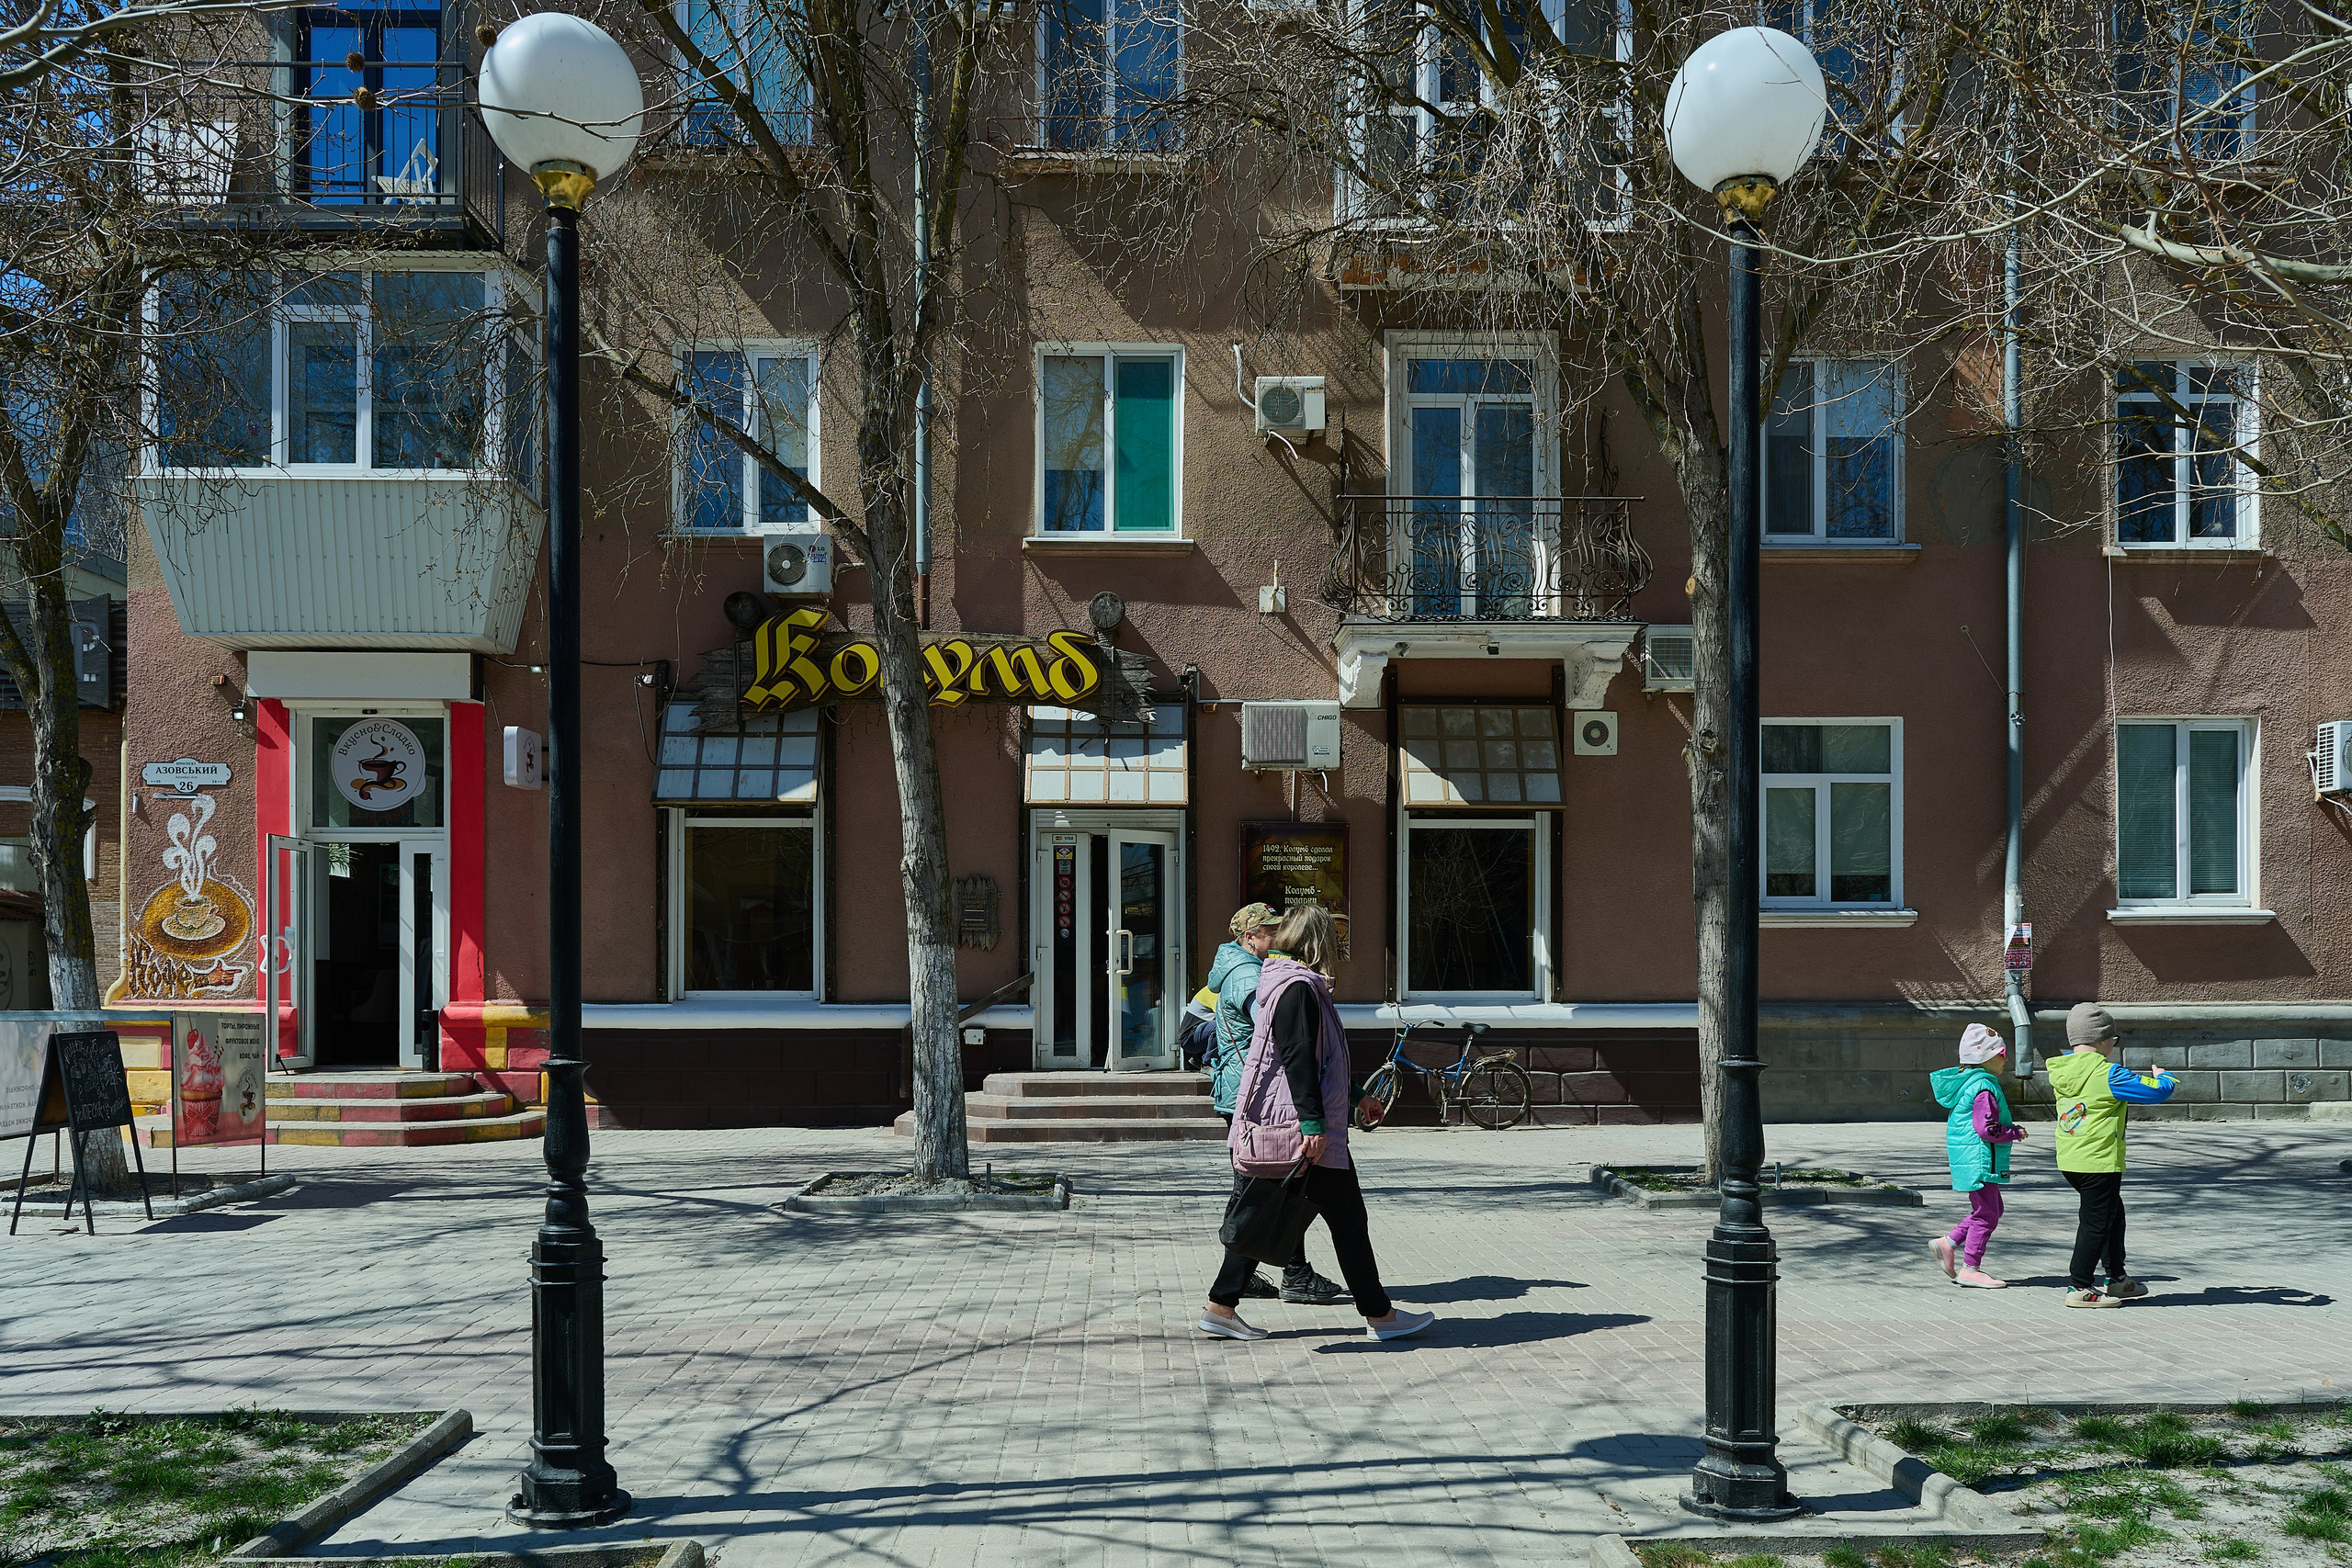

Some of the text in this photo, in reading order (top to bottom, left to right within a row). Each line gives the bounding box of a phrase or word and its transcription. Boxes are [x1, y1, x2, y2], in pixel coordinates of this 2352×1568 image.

[741, 605, 1102, 711] Коумб
[155, 765, 218, 774] АЗОВСЬКИЙ
[179, 781, 194, 791] 26
[1262, 844, 1333, 854] 1492. Колумб сделал
[1262, 854, 1331, 863] прекрасный подарок
[1262, 863, 1281, 871] своей
[1284, 885, 1316, 896] Колумб
[1284, 897, 1317, 905] подарки
[237, 1022, 260, 1031] ПИРОЖНЫЕ
